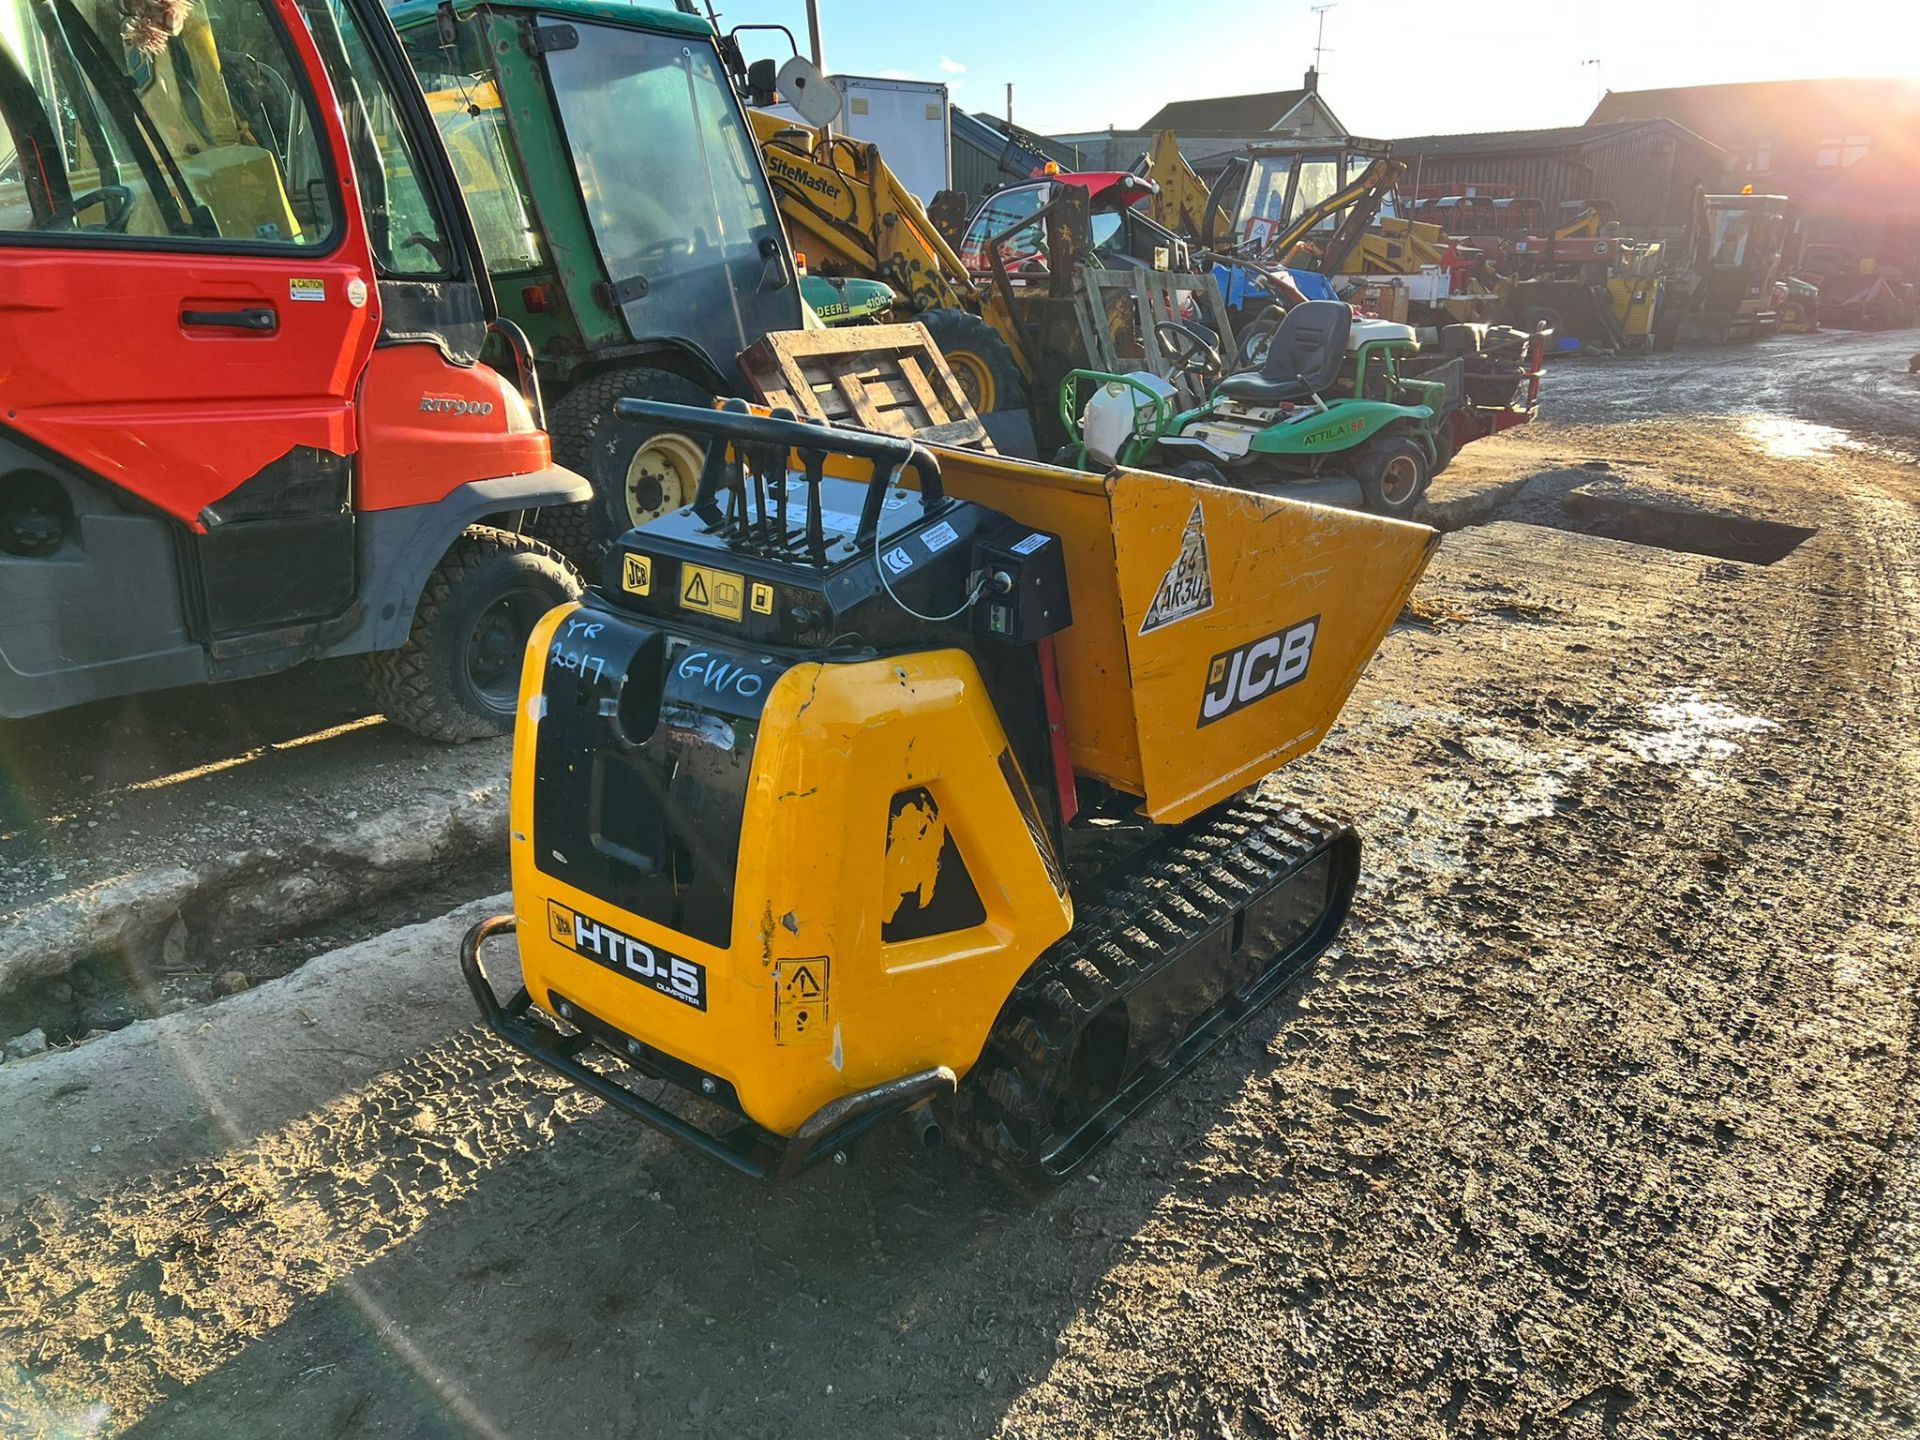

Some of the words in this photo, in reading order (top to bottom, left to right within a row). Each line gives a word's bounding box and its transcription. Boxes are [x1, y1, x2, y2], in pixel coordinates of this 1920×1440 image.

[769, 156, 841, 198] SiteMaster
[297, 280, 323, 288] CAUTION
[816, 302, 850, 317] DEERE
[420, 397, 493, 416] RTV900
[1304, 425, 1346, 447] ATTILA
[628, 560, 648, 586] JCB
[567, 619, 605, 639] YR
[551, 641, 606, 685] 2017
[1203, 621, 1315, 718] JCB
[575, 914, 699, 997] HTD-5
[656, 982, 700, 1005] DUMPSTER
